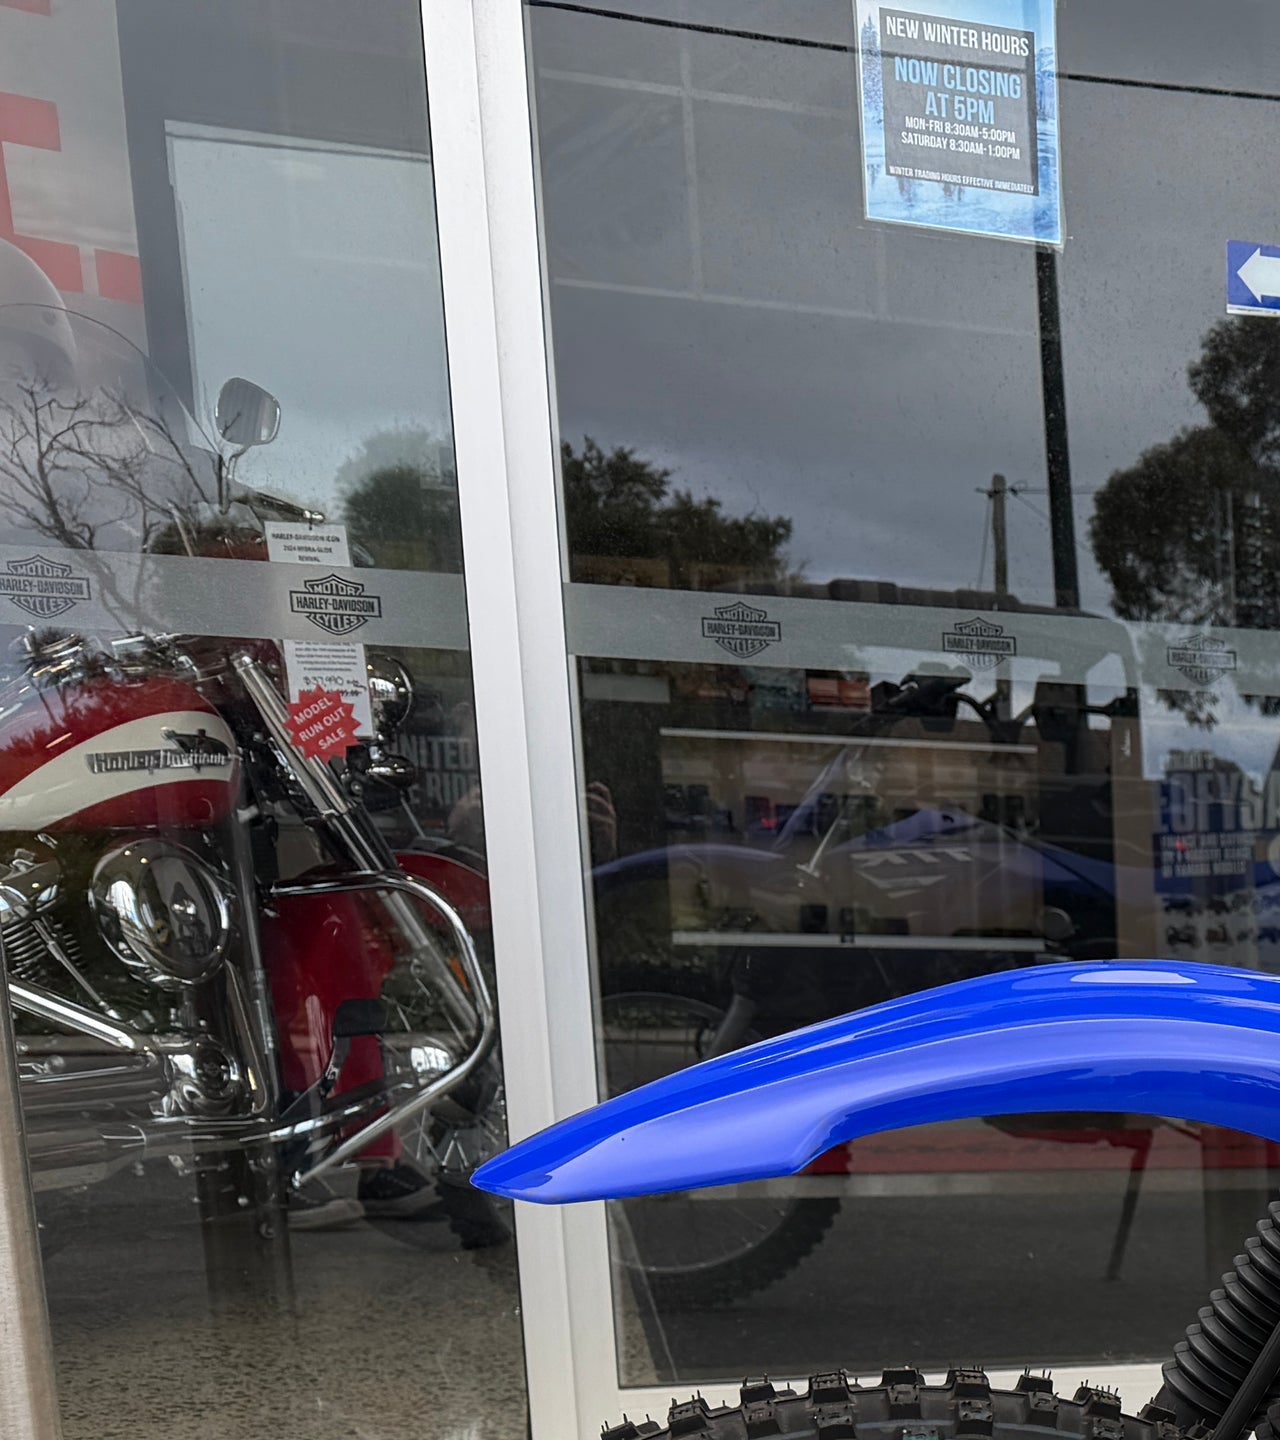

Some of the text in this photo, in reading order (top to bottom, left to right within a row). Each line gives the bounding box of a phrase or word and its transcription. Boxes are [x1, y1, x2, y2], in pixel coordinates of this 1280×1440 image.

[886, 16, 1029, 56] NEW WINTER HOURS
[895, 57, 1022, 99] NOW CLOSING
[925, 91, 995, 125] AT 5PM
[905, 116, 1016, 144] MON-FRI 8:30AM-5:00PM
[901, 132, 1020, 160] SATURDAY 8:30AM-1:00PM
[17, 561, 63, 577] MOTOR
[0, 578, 84, 596] HARLEY-DAVIDSON
[313, 579, 357, 596] MOTOR
[296, 596, 375, 613] HARLEY-DAVIDSON
[312, 616, 361, 635] CYCLES
[293, 696, 333, 725] MODEL
[298, 707, 347, 743] RUN OUT
[318, 728, 347, 750] SALE
